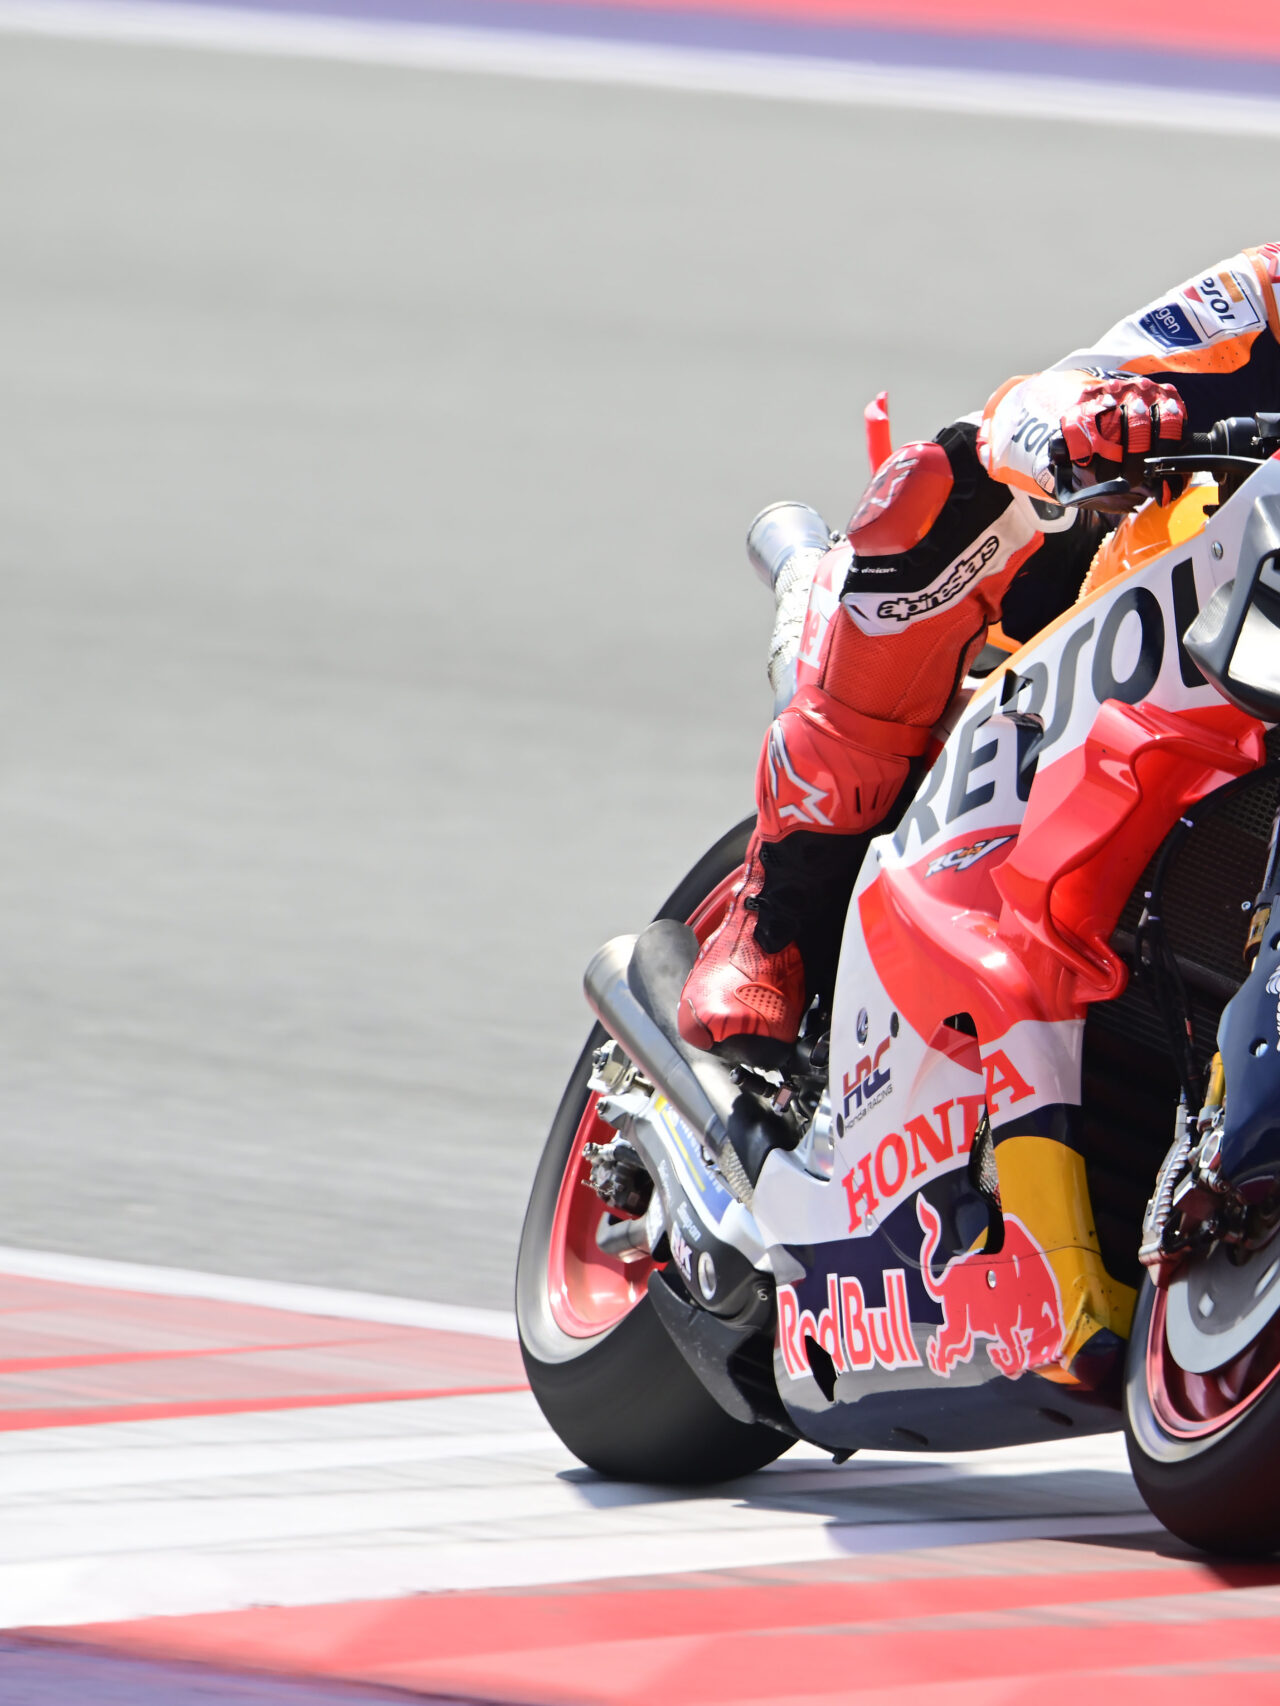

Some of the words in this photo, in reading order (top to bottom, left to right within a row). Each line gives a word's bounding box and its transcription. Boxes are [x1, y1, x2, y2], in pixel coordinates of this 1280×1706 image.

[876, 535, 999, 622] alpinestars
[842, 1034, 891, 1120] HRC
[867, 1082, 894, 1110] RACING
[839, 1268, 924, 1372] Bull
